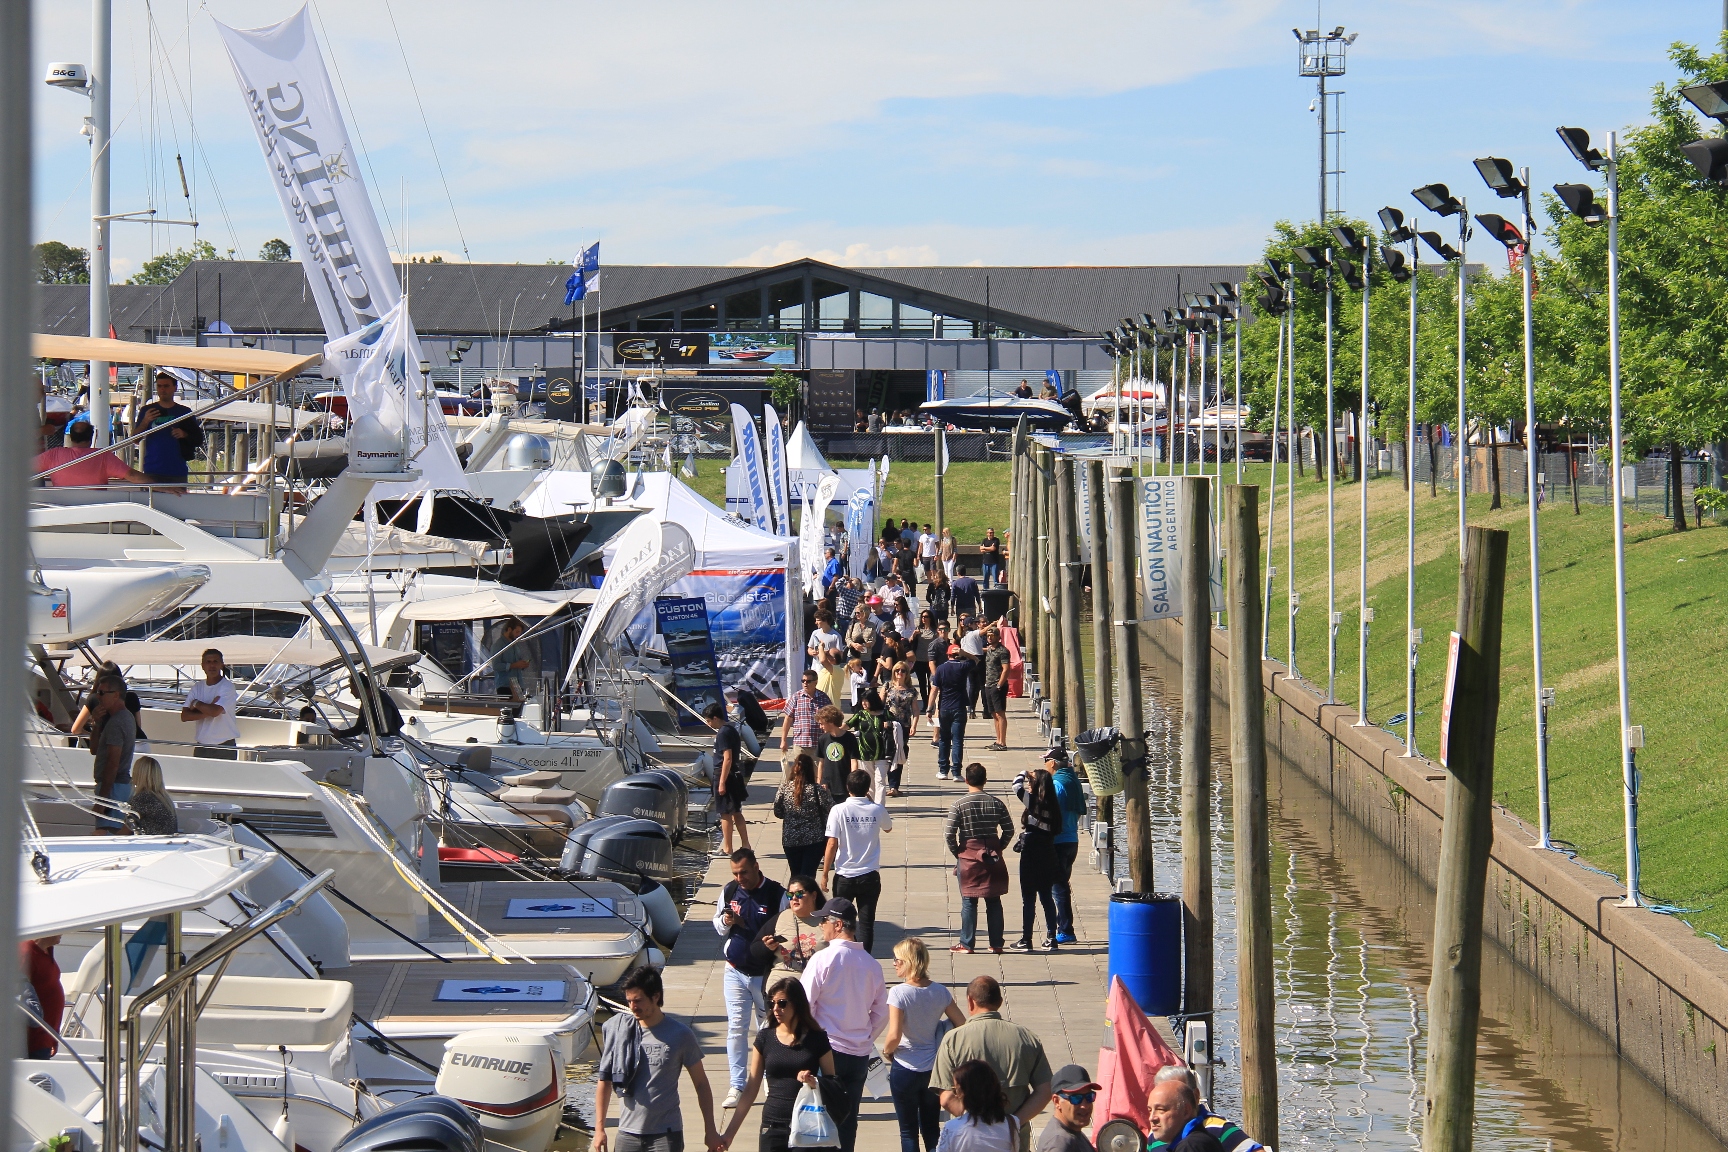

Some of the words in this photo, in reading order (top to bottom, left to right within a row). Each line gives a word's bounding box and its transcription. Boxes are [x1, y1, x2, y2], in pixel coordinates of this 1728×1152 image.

[52, 69, 76, 77] B&G
[357, 450, 400, 460] Raymarine
[1144, 480, 1164, 554] NAUTICO
[1165, 480, 1178, 551] ARGENTINO
[1149, 557, 1170, 614] SALON
[704, 589, 775, 604] Globalstar
[658, 602, 704, 615] CUSTON
[572, 749, 583, 757] REY
[518, 757, 558, 767] Oceanis
[640, 808, 666, 819] YAMAHA
[644, 861, 669, 873] YAMAHA
[451, 1052, 533, 1076] EVINRUDE
